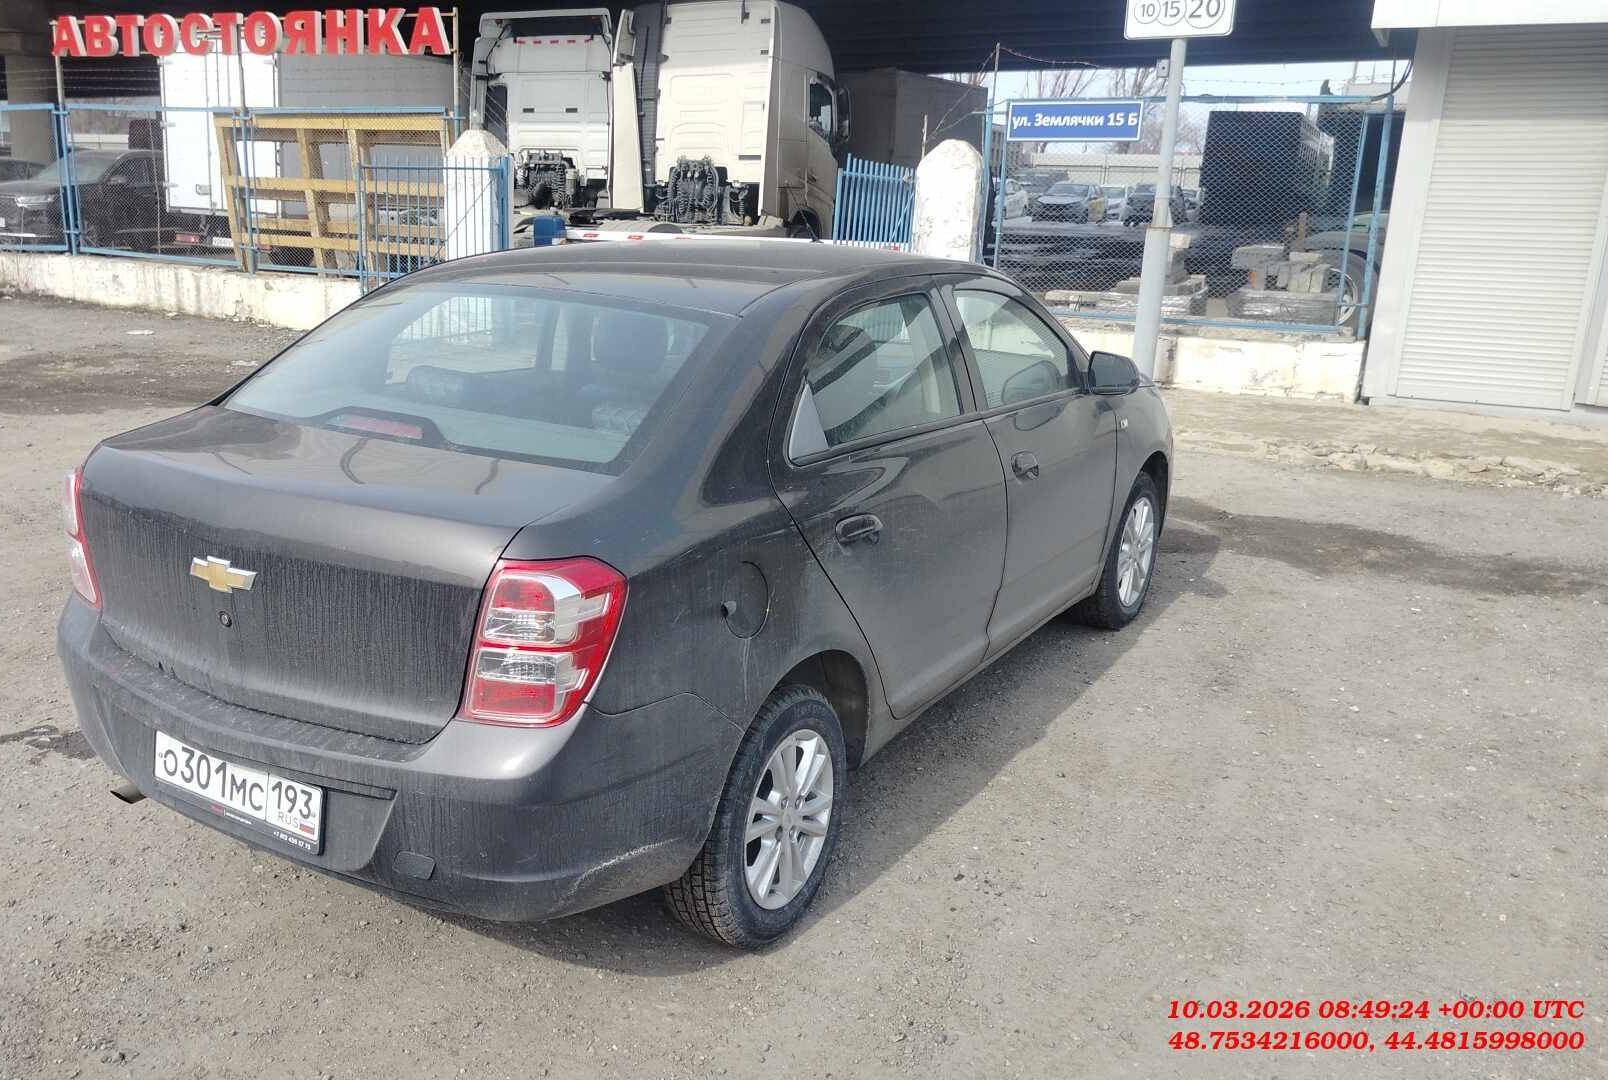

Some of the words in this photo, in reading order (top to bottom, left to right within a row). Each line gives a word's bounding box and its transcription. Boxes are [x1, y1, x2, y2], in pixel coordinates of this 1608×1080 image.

[1141, 3, 1155, 17] 10
[1162, 1, 1180, 18] 15
[1188, 0, 1221, 18] 20
[52, 7, 450, 57] АВТОСТОЯНКА
[1012, 117, 1031, 129] ул.
[1034, 112, 1104, 127] Землячки
[1107, 112, 1124, 126] 15
[1127, 112, 1138, 126] Б
[271, 780, 313, 820] 193
[277, 811, 299, 829] RUS
